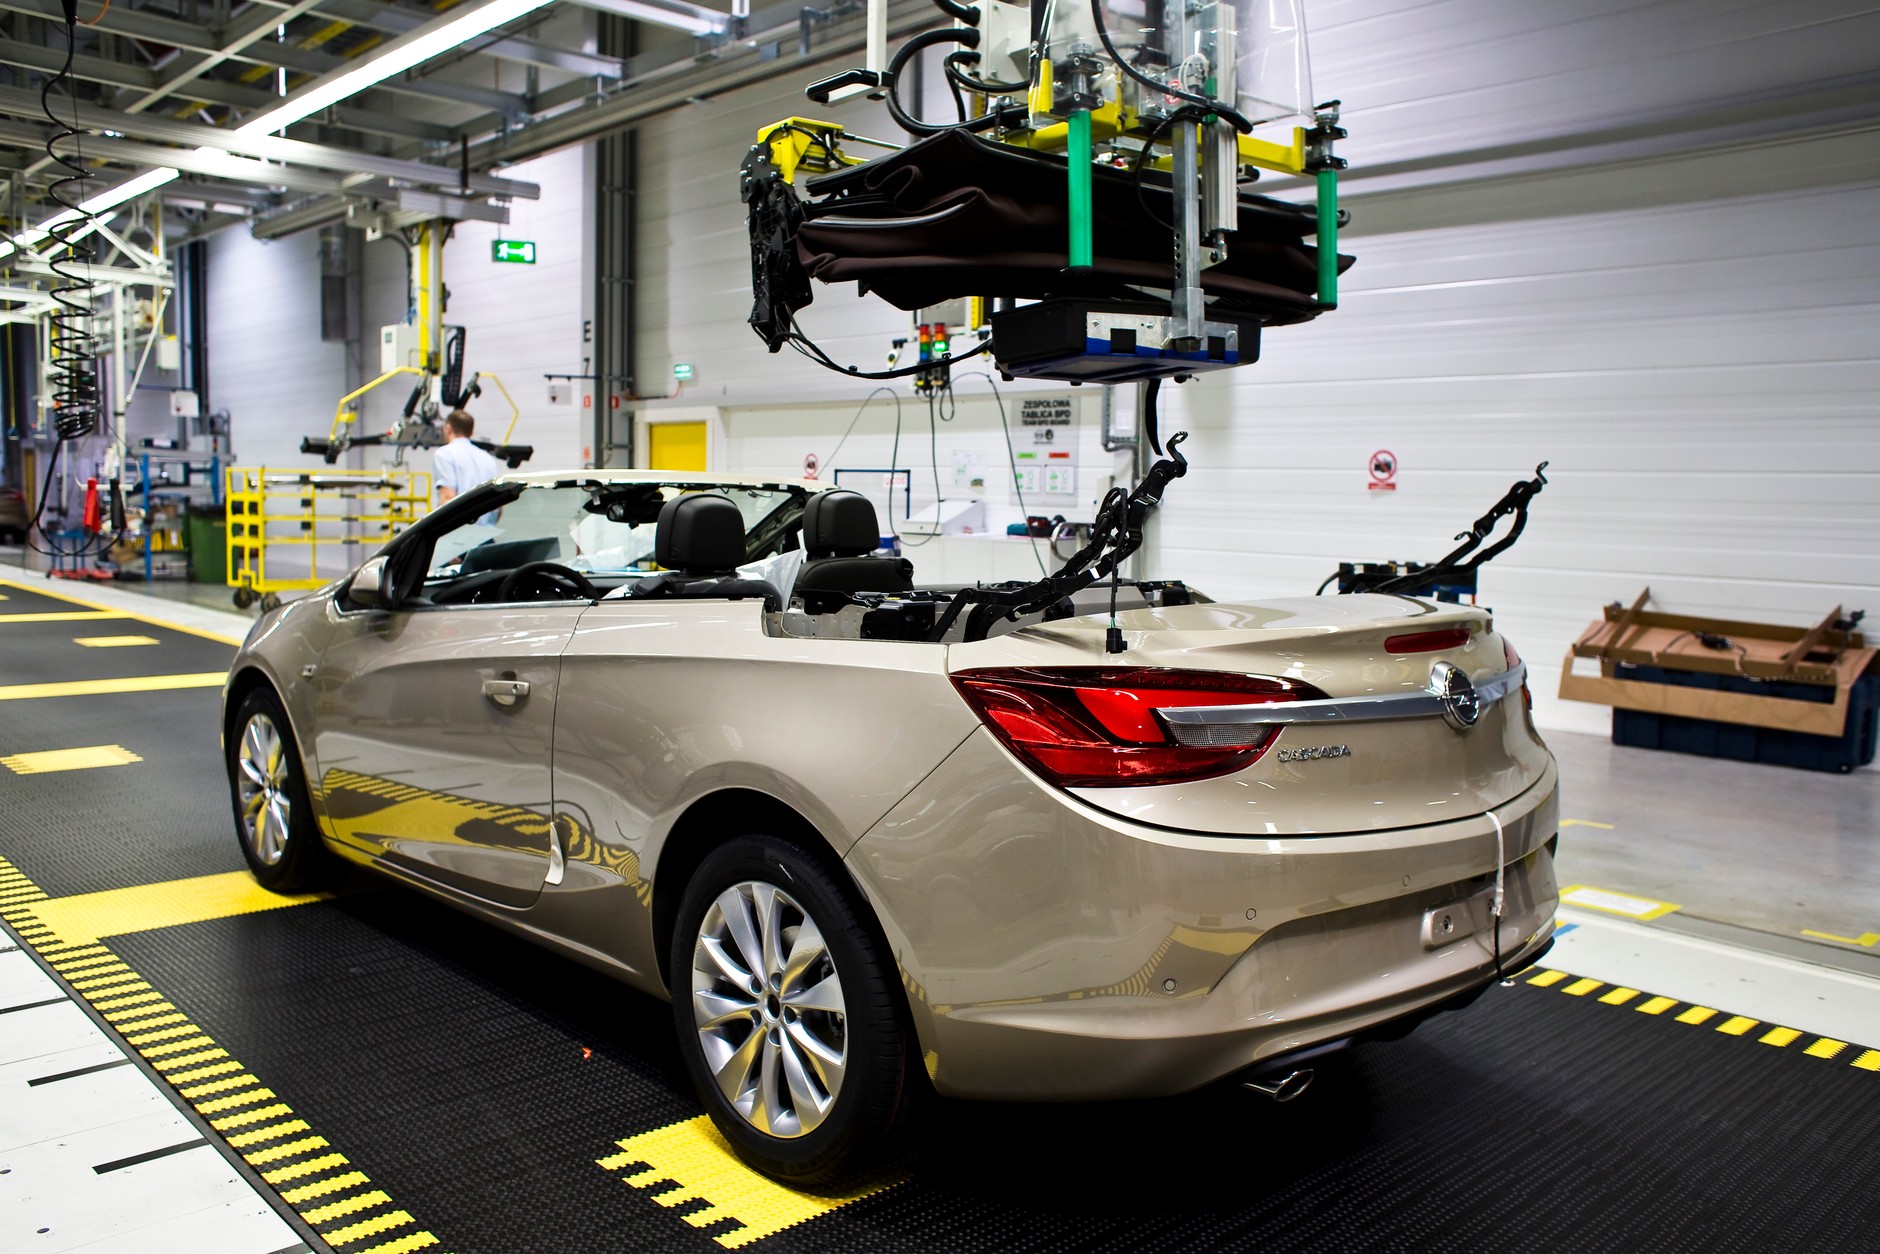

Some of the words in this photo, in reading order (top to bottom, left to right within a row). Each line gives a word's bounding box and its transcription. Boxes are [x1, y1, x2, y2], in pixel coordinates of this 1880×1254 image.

[583, 320, 592, 342] E
[1021, 410, 1052, 418] TABLICA
[1277, 744, 1351, 762] CASCADA
